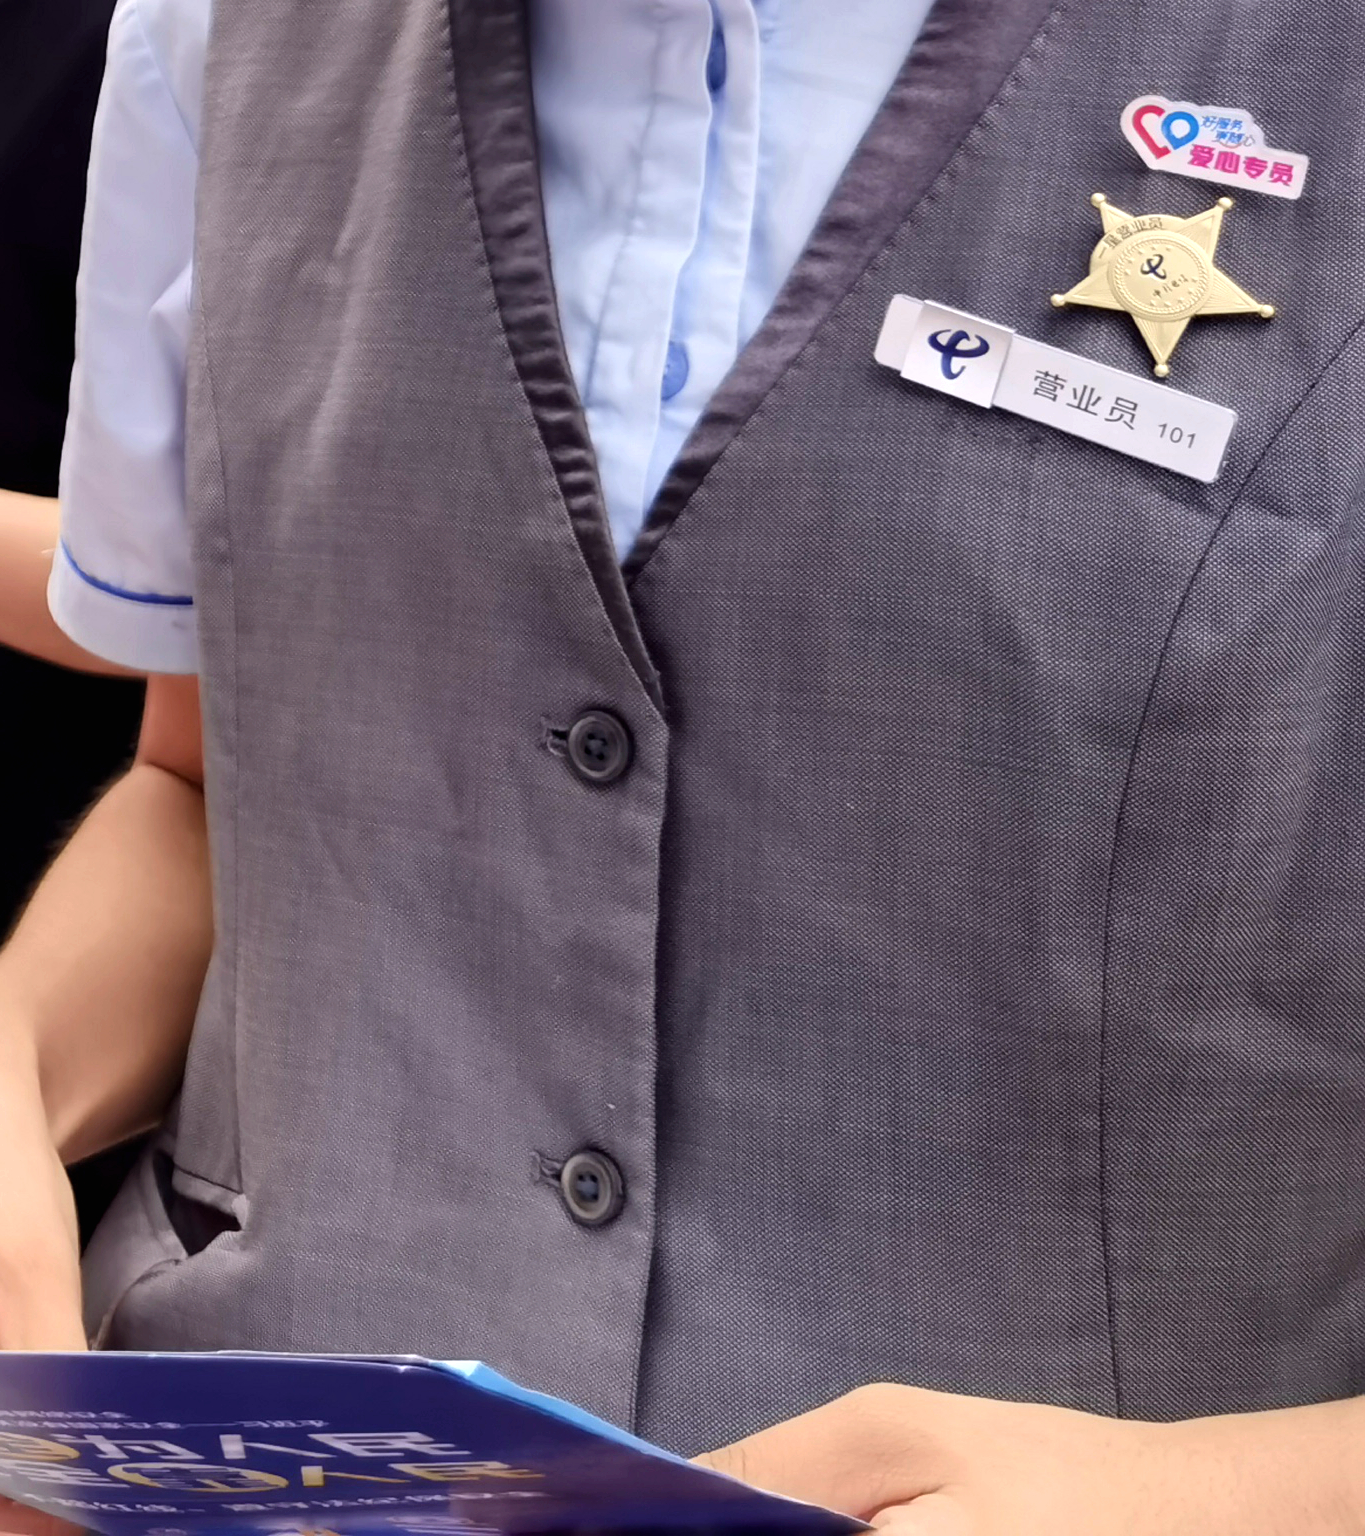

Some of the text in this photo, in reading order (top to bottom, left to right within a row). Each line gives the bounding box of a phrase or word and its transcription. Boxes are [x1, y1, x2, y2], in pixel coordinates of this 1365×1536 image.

[1187, 144, 1295, 187] 爱心专员
[1033, 369, 1197, 449] 营业员 101
